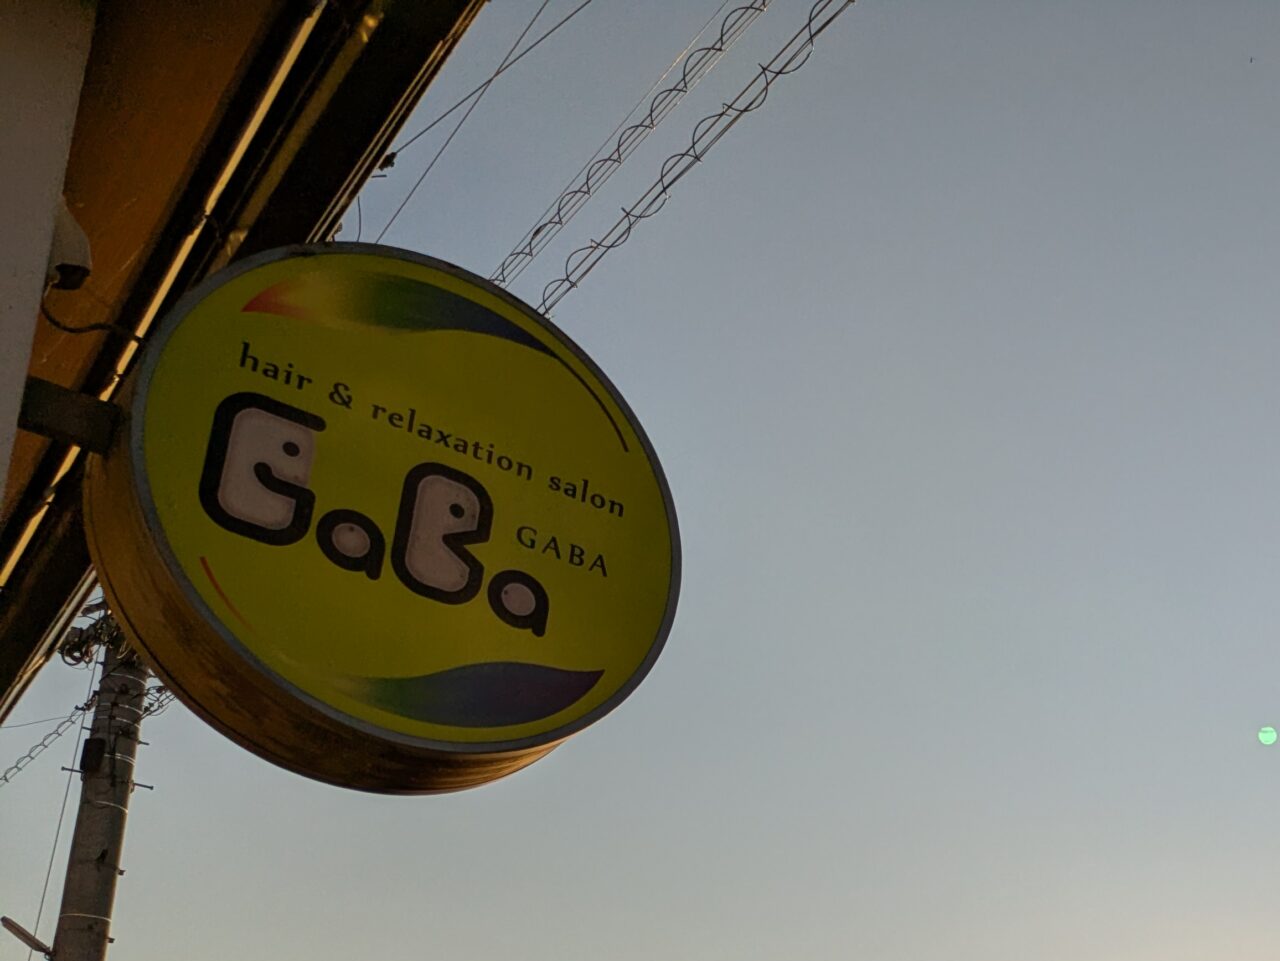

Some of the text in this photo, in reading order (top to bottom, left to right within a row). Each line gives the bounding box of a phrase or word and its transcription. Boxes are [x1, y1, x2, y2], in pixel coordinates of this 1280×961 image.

[239, 341, 625, 518] hair & relaxation salon
[515, 525, 609, 578] GABA
